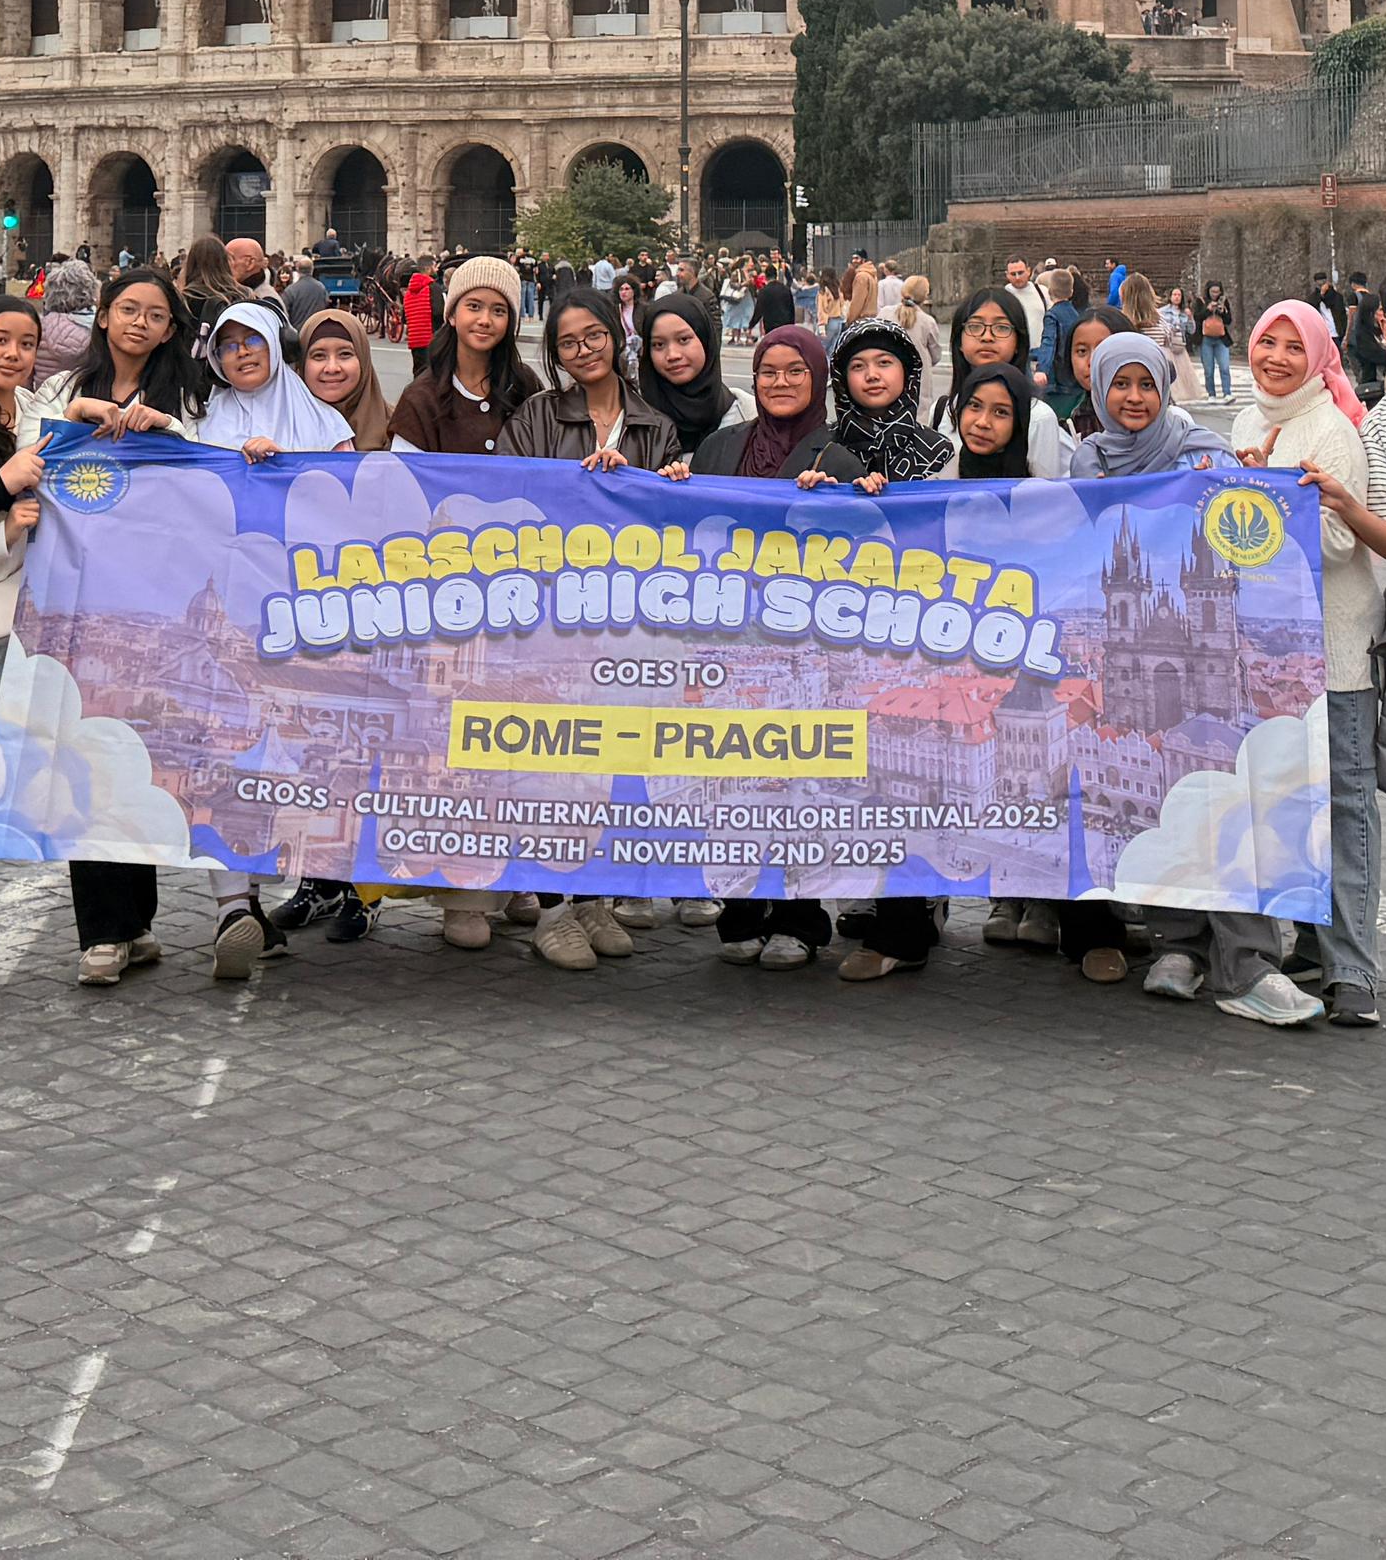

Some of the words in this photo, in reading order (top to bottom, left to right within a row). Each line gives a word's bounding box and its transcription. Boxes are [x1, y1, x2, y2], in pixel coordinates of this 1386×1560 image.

[1249, 477, 1270, 489] SMP
[1277, 495, 1293, 517] SMA
[293, 523, 701, 592] LABSCHOOL
[716, 527, 1035, 618] JAKARTA
[262, 573, 540, 653] JUNIOR
[555, 570, 747, 627] HIGH
[760, 578, 1063, 676] SCHOOL
[592, 659, 676, 687] GOES
[684, 661, 726, 688] TO
[461, 714, 603, 757] ROME
[653, 721, 854, 762] PRAGUE
[236, 777, 329, 809] CROSS
[353, 791, 489, 822] CULTURAL
[497, 799, 707, 829] INTERNATIONAL
[715, 805, 852, 830] FOLKLORE
[860, 805, 978, 829] FESTIVAL
[983, 805, 1059, 829] 2025
[384, 828, 511, 858] OCTOBER
[518, 835, 586, 862] 25TH
[613, 840, 760, 865] NOVEMBER
[768, 841, 825, 865] 2ND
[833, 841, 906, 865] 2025
